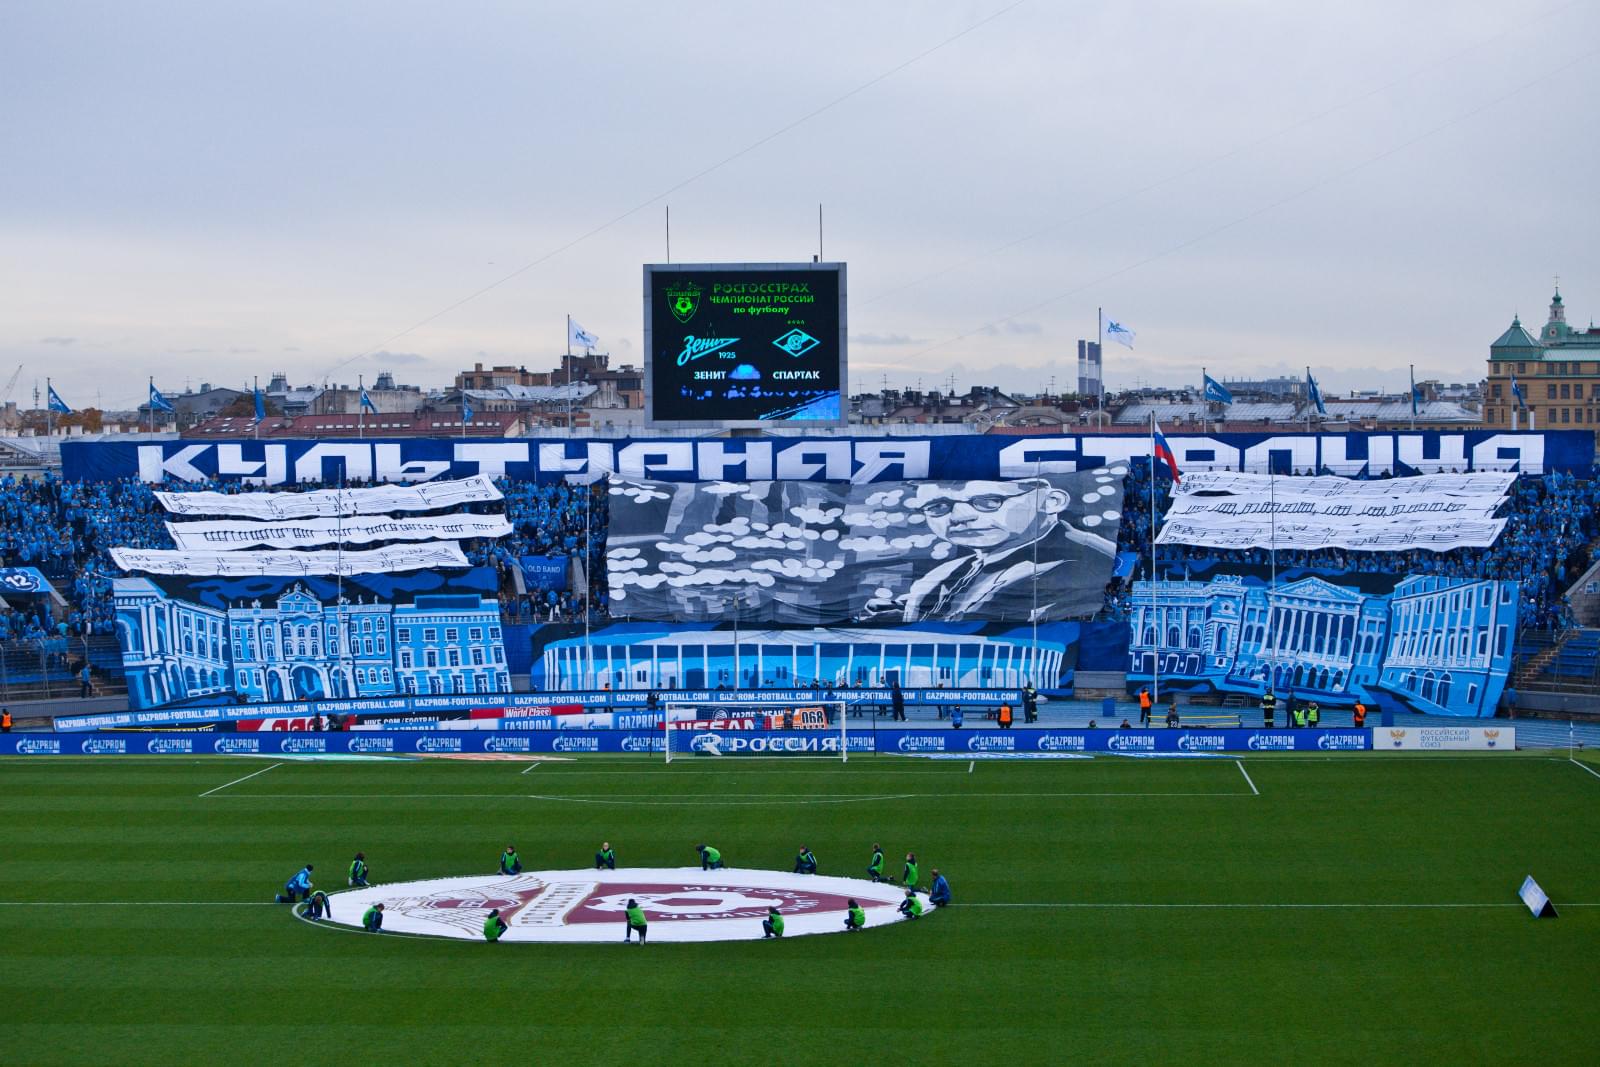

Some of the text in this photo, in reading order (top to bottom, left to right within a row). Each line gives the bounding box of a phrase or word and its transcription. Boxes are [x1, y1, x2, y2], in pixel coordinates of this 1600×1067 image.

[713, 283, 809, 293] РОСГОССТРАХ
[709, 295, 814, 304] ЧЕМПИОНАТ РОССИИ
[748, 304, 790, 316] футболу
[719, 352, 736, 360] 1925
[693, 371, 727, 380] ЗЕНИТ
[772, 371, 821, 380] СПАРТАК
[137, 439, 931, 486] КУЛЬТУРНАЯ
[527, 565, 561, 574] OLD BAND
[5, 575, 32, 588] 12
[514, 695, 607, 705] GAZPROM-FOOTBALL.COM
[616, 693, 710, 702] GAZPROOOTBALL.COM
[719, 692, 812, 701] GAZROM-FOOTBALL.COM
[822, 692, 916, 700] GPROM-FOOTBALOM
[925, 692, 1018, 701] GAZPROM-FOOTBALL.COM
[414, 696, 506, 706] GAZPROM-FOOTBALL.COM
[226, 704, 309, 717] GAZPROM-FOOTBALL.COM
[316, 700, 406, 712] GAZPROM-FOOTBALL.COM
[137, 708, 220, 723] GAZPROM-FOOTBALL.COM
[505, 706, 551, 718] World Class
[57, 714, 130, 728] GAZPROM-FOOTBALL.COM
[363, 715, 439, 726] NIKECOM/FOOTBALL
[27, 740, 59, 749] GAZPROM
[93, 740, 125, 749] GAZPROM
[159, 740, 192, 749] GAZPROM
[225, 739, 259, 748] GAZPROM
[292, 739, 325, 748] GAZPROM
[359, 738, 393, 747] GAZPROM
[427, 738, 461, 747] GAZPROM
[495, 738, 529, 747] GAZPROM
[564, 738, 598, 747] GAZPROM
[733, 737, 838, 751] РОССИЯ
[910, 737, 944, 746] GAZPROM
[979, 737, 1014, 746] GAZPROM
[1049, 736, 1084, 745] GAZPROM
[1119, 736, 1154, 745] GAZPROM
[1189, 736, 1224, 745] GAZPROM
[1259, 736, 1294, 745] GAZPROM
[1329, 736, 1364, 745] GAZPROM
